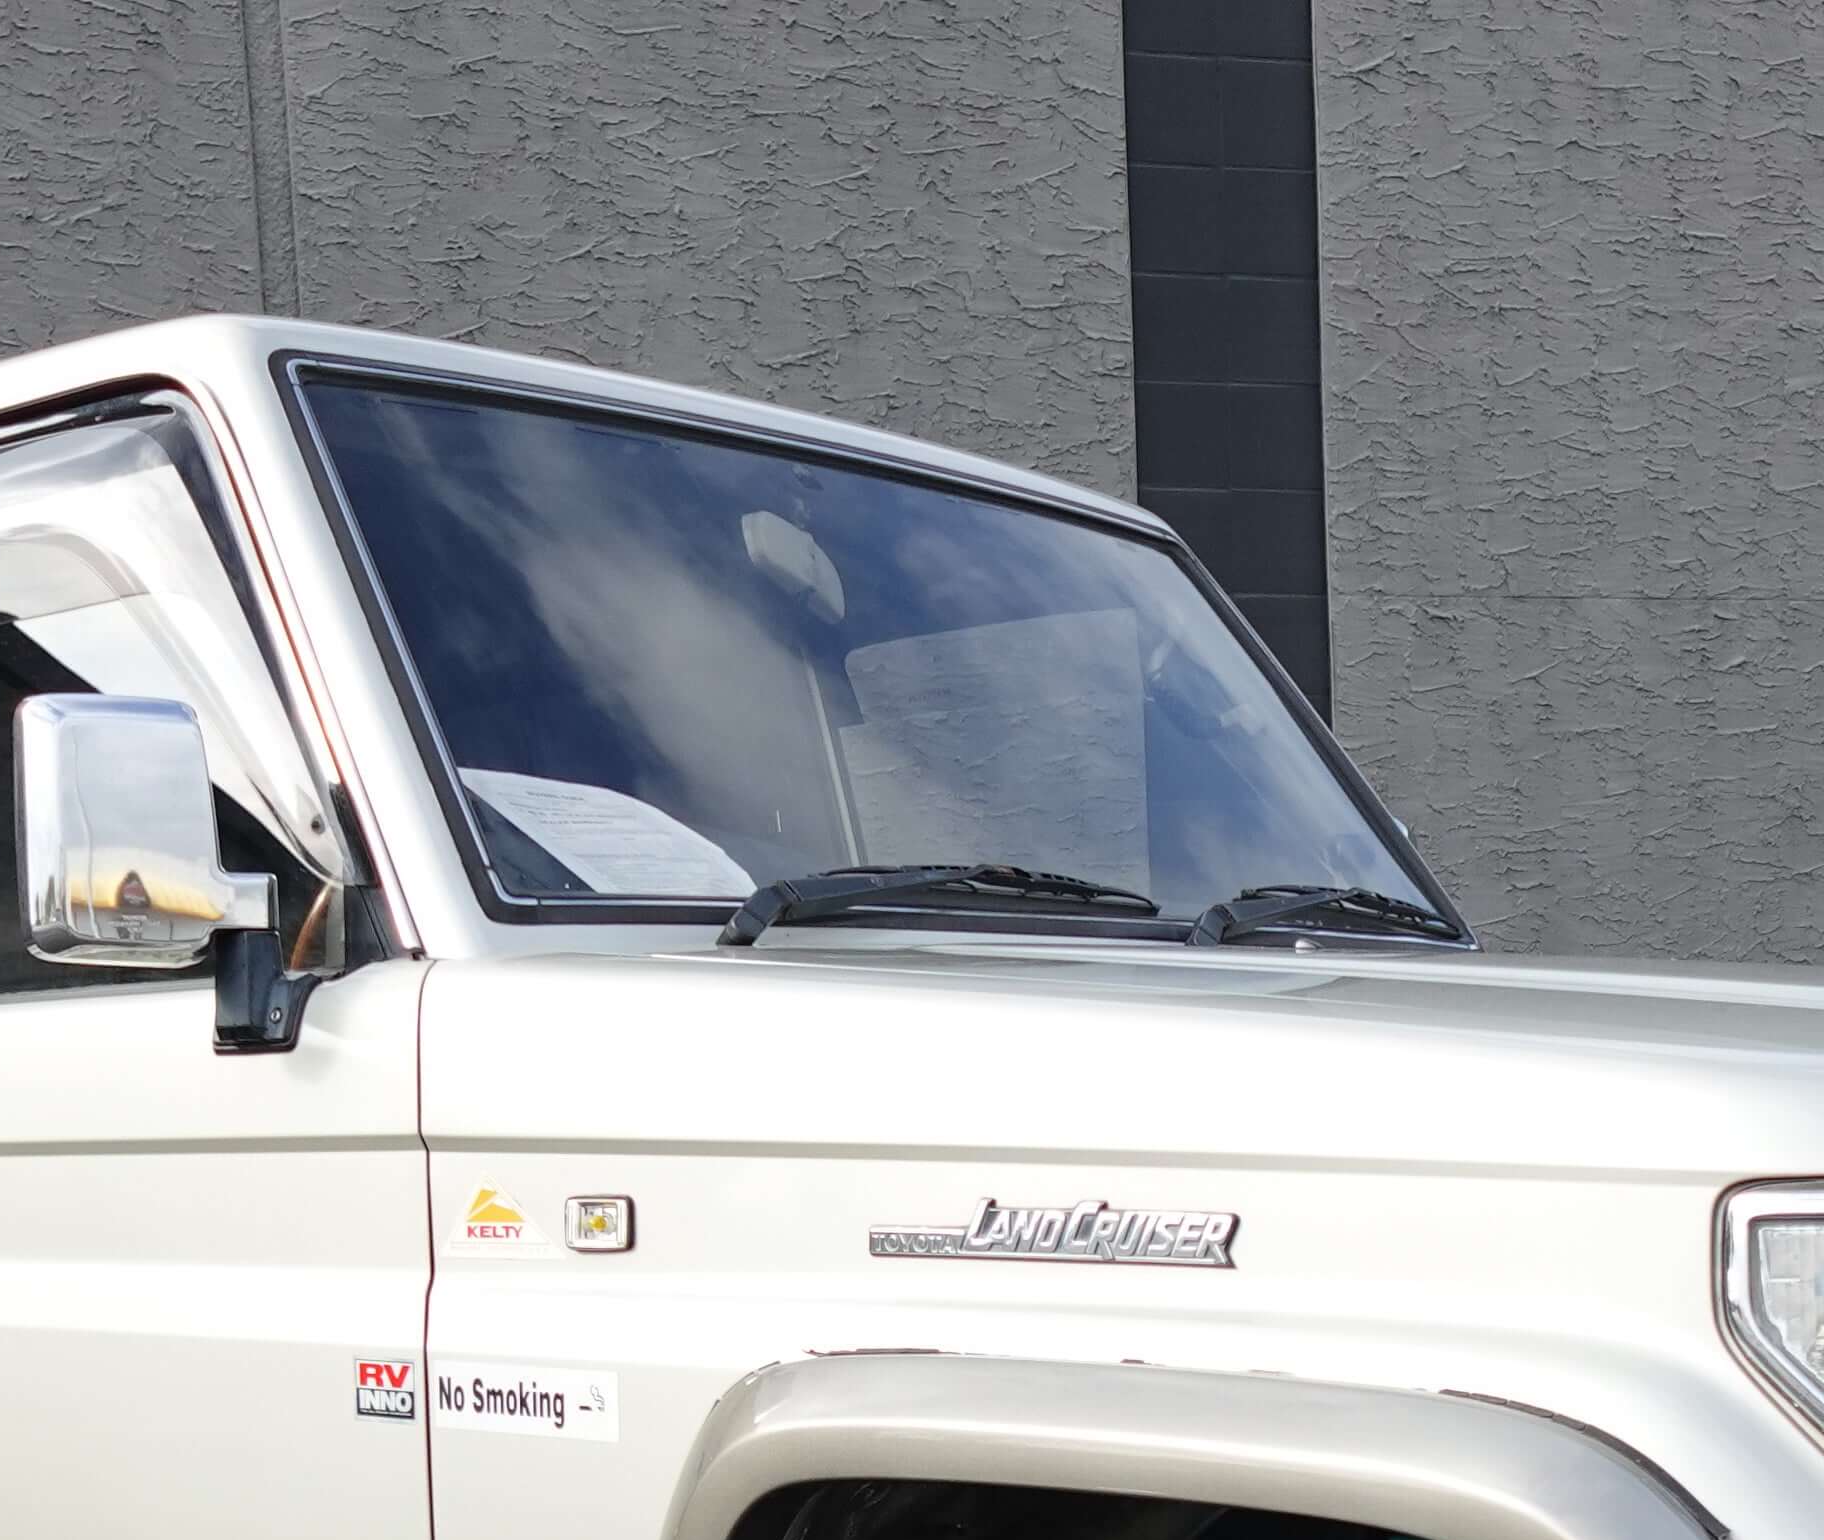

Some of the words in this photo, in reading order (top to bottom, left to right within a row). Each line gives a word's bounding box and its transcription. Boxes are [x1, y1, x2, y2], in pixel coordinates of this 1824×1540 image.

[466, 1224, 523, 1239] KELTY
[873, 1234, 960, 1255] TOYOTA
[359, 1362, 411, 1388] RV
[359, 1388, 413, 1413] INNO
[438, 1375, 465, 1413] No
[472, 1377, 565, 1430] Smoking
